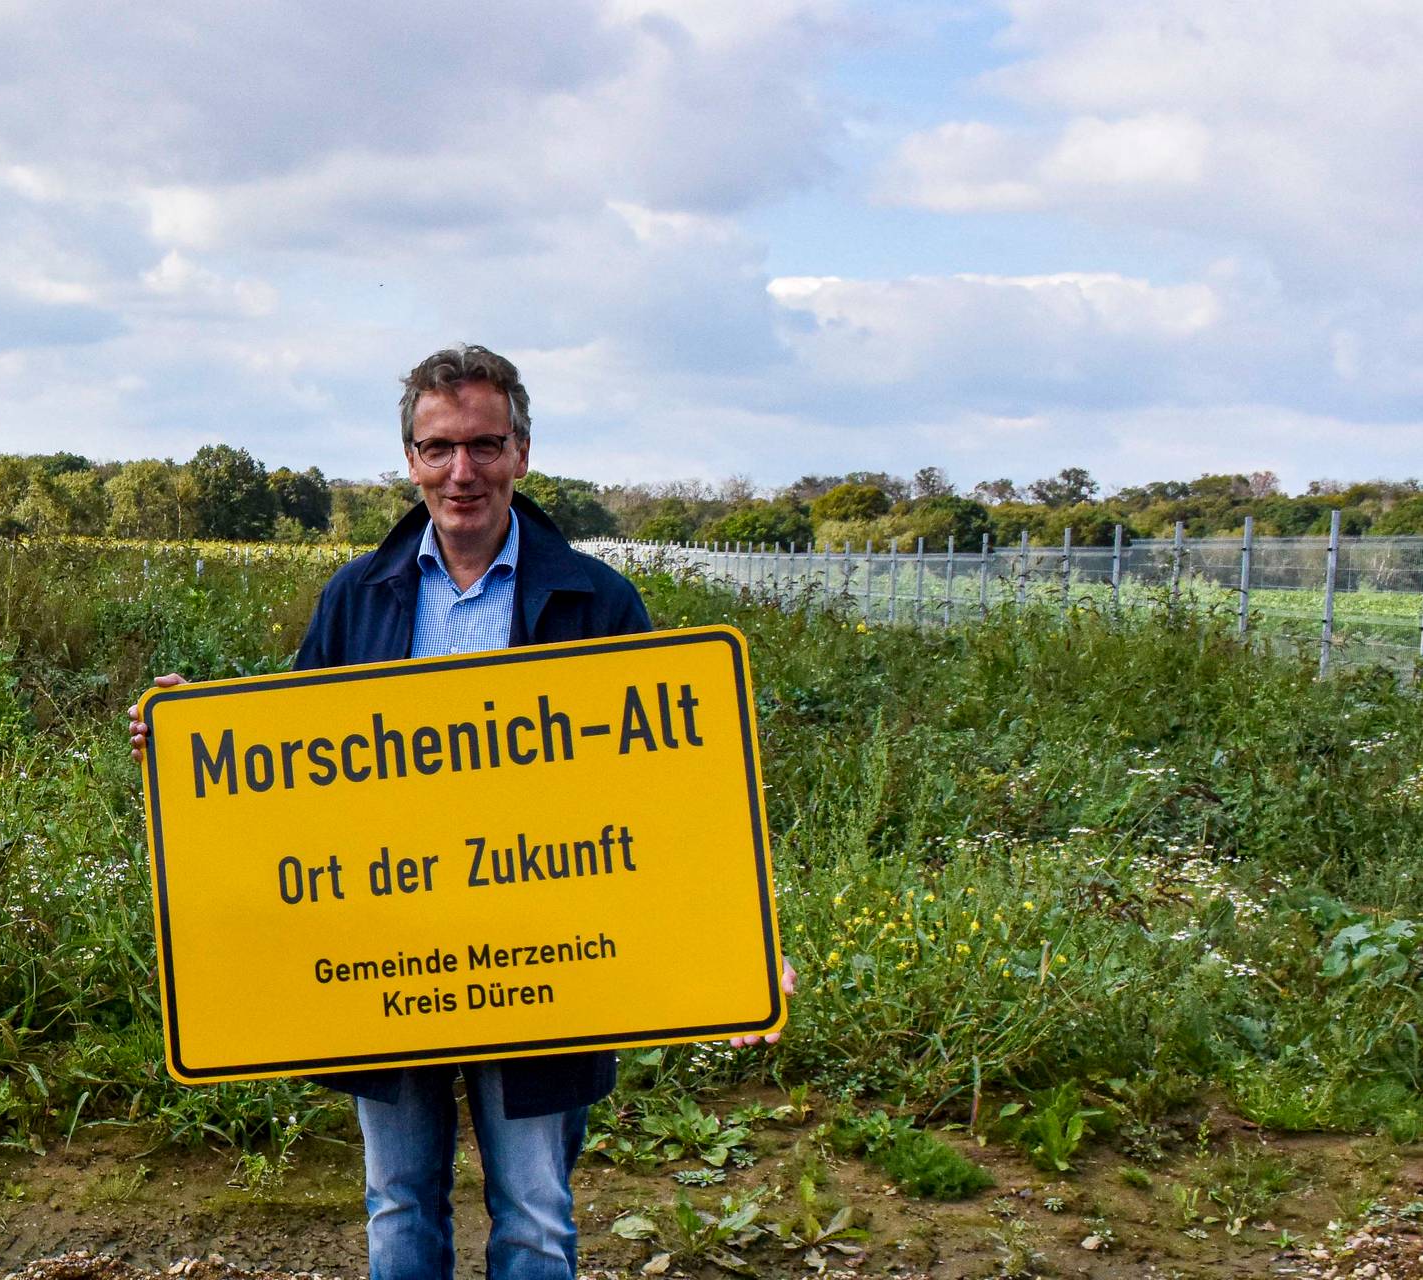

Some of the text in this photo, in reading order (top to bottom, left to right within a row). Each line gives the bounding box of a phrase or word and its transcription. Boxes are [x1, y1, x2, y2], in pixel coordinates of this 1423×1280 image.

[190, 682, 704, 799] Morschenich-Alt
[278, 824, 637, 905] Ort der Zukunft
[314, 932, 617, 984] Gemeinde Merzenich
[382, 981, 555, 1018] Kreis Düren
